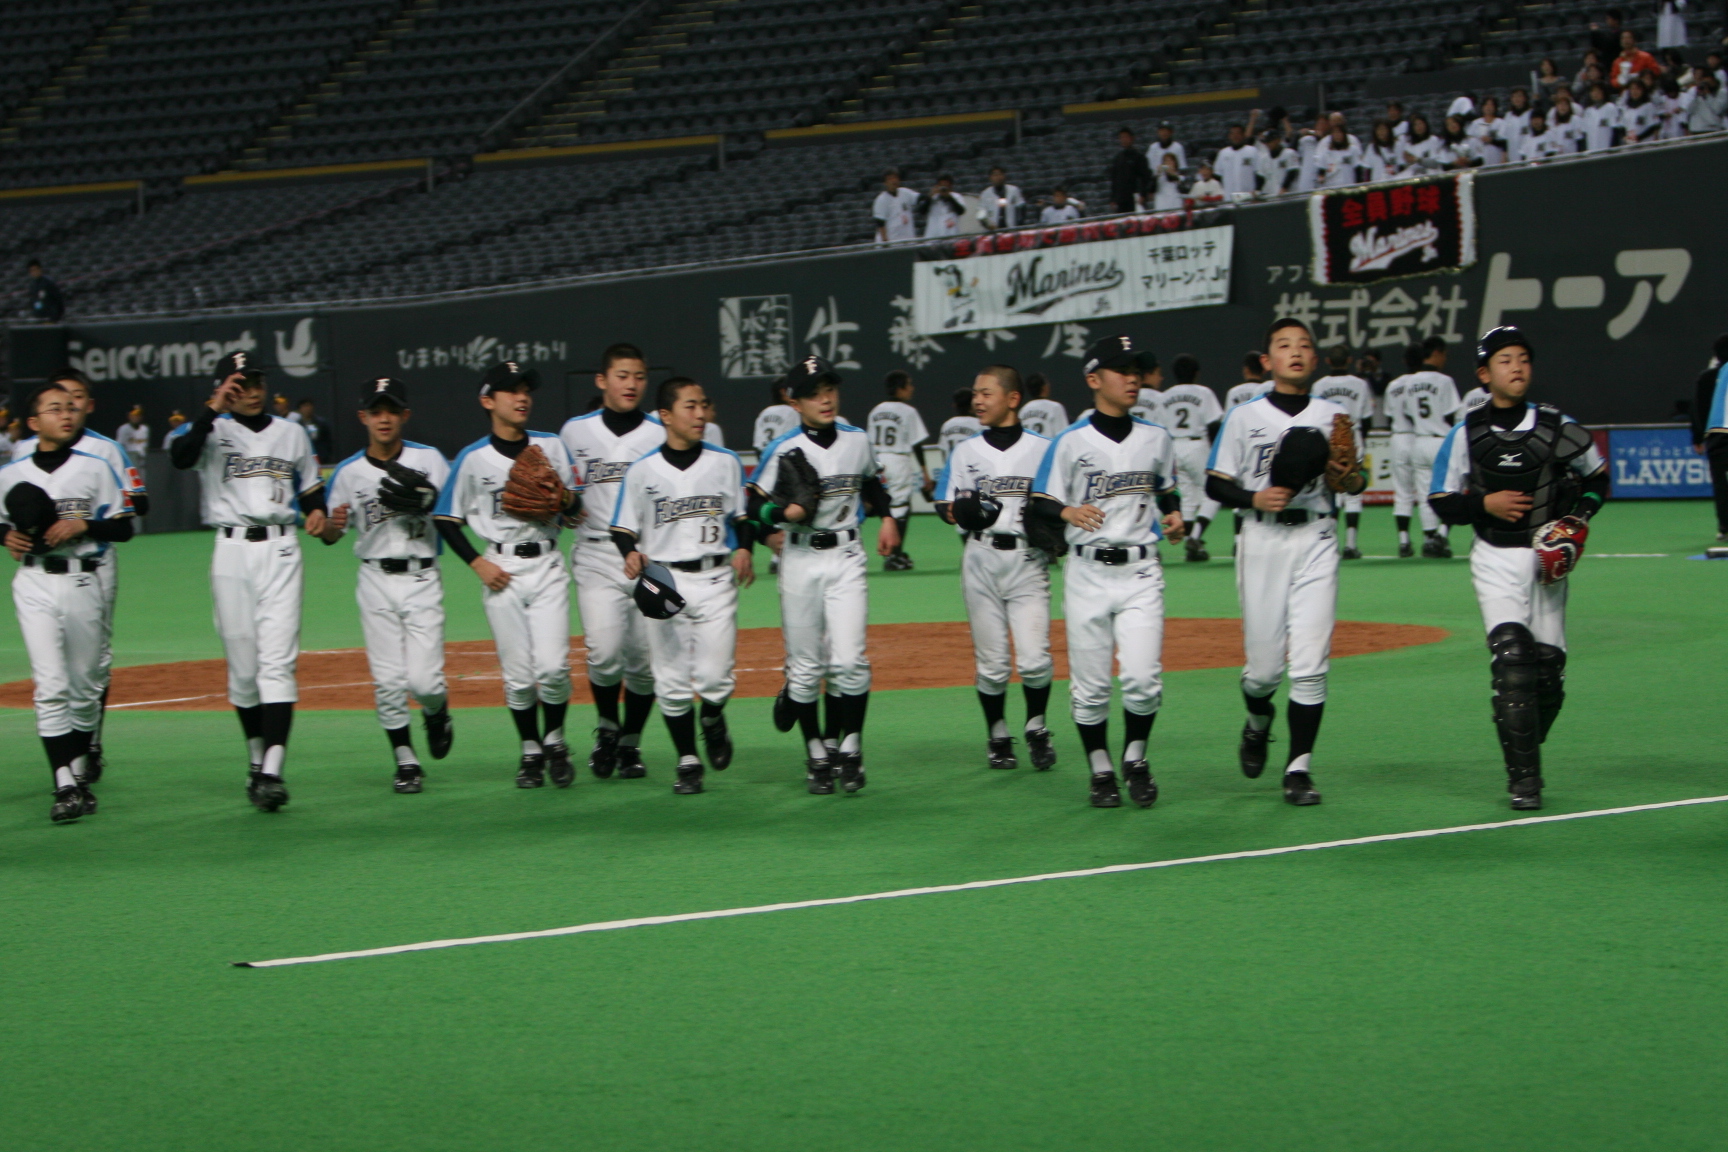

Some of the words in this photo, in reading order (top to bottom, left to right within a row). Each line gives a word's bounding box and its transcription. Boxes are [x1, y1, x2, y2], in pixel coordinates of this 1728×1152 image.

[1148, 241, 1216, 263] 千葉ロッテ
[1006, 255, 1125, 308] Marines
[1273, 284, 1468, 348] 株式会社
[1477, 248, 1692, 341] トーア
[1175, 407, 1190, 429] 2
[1417, 396, 1431, 419] 5
[874, 425, 898, 447] 16
[652, 495, 724, 529] FIGHTERS
[701, 525, 720, 544] 13
